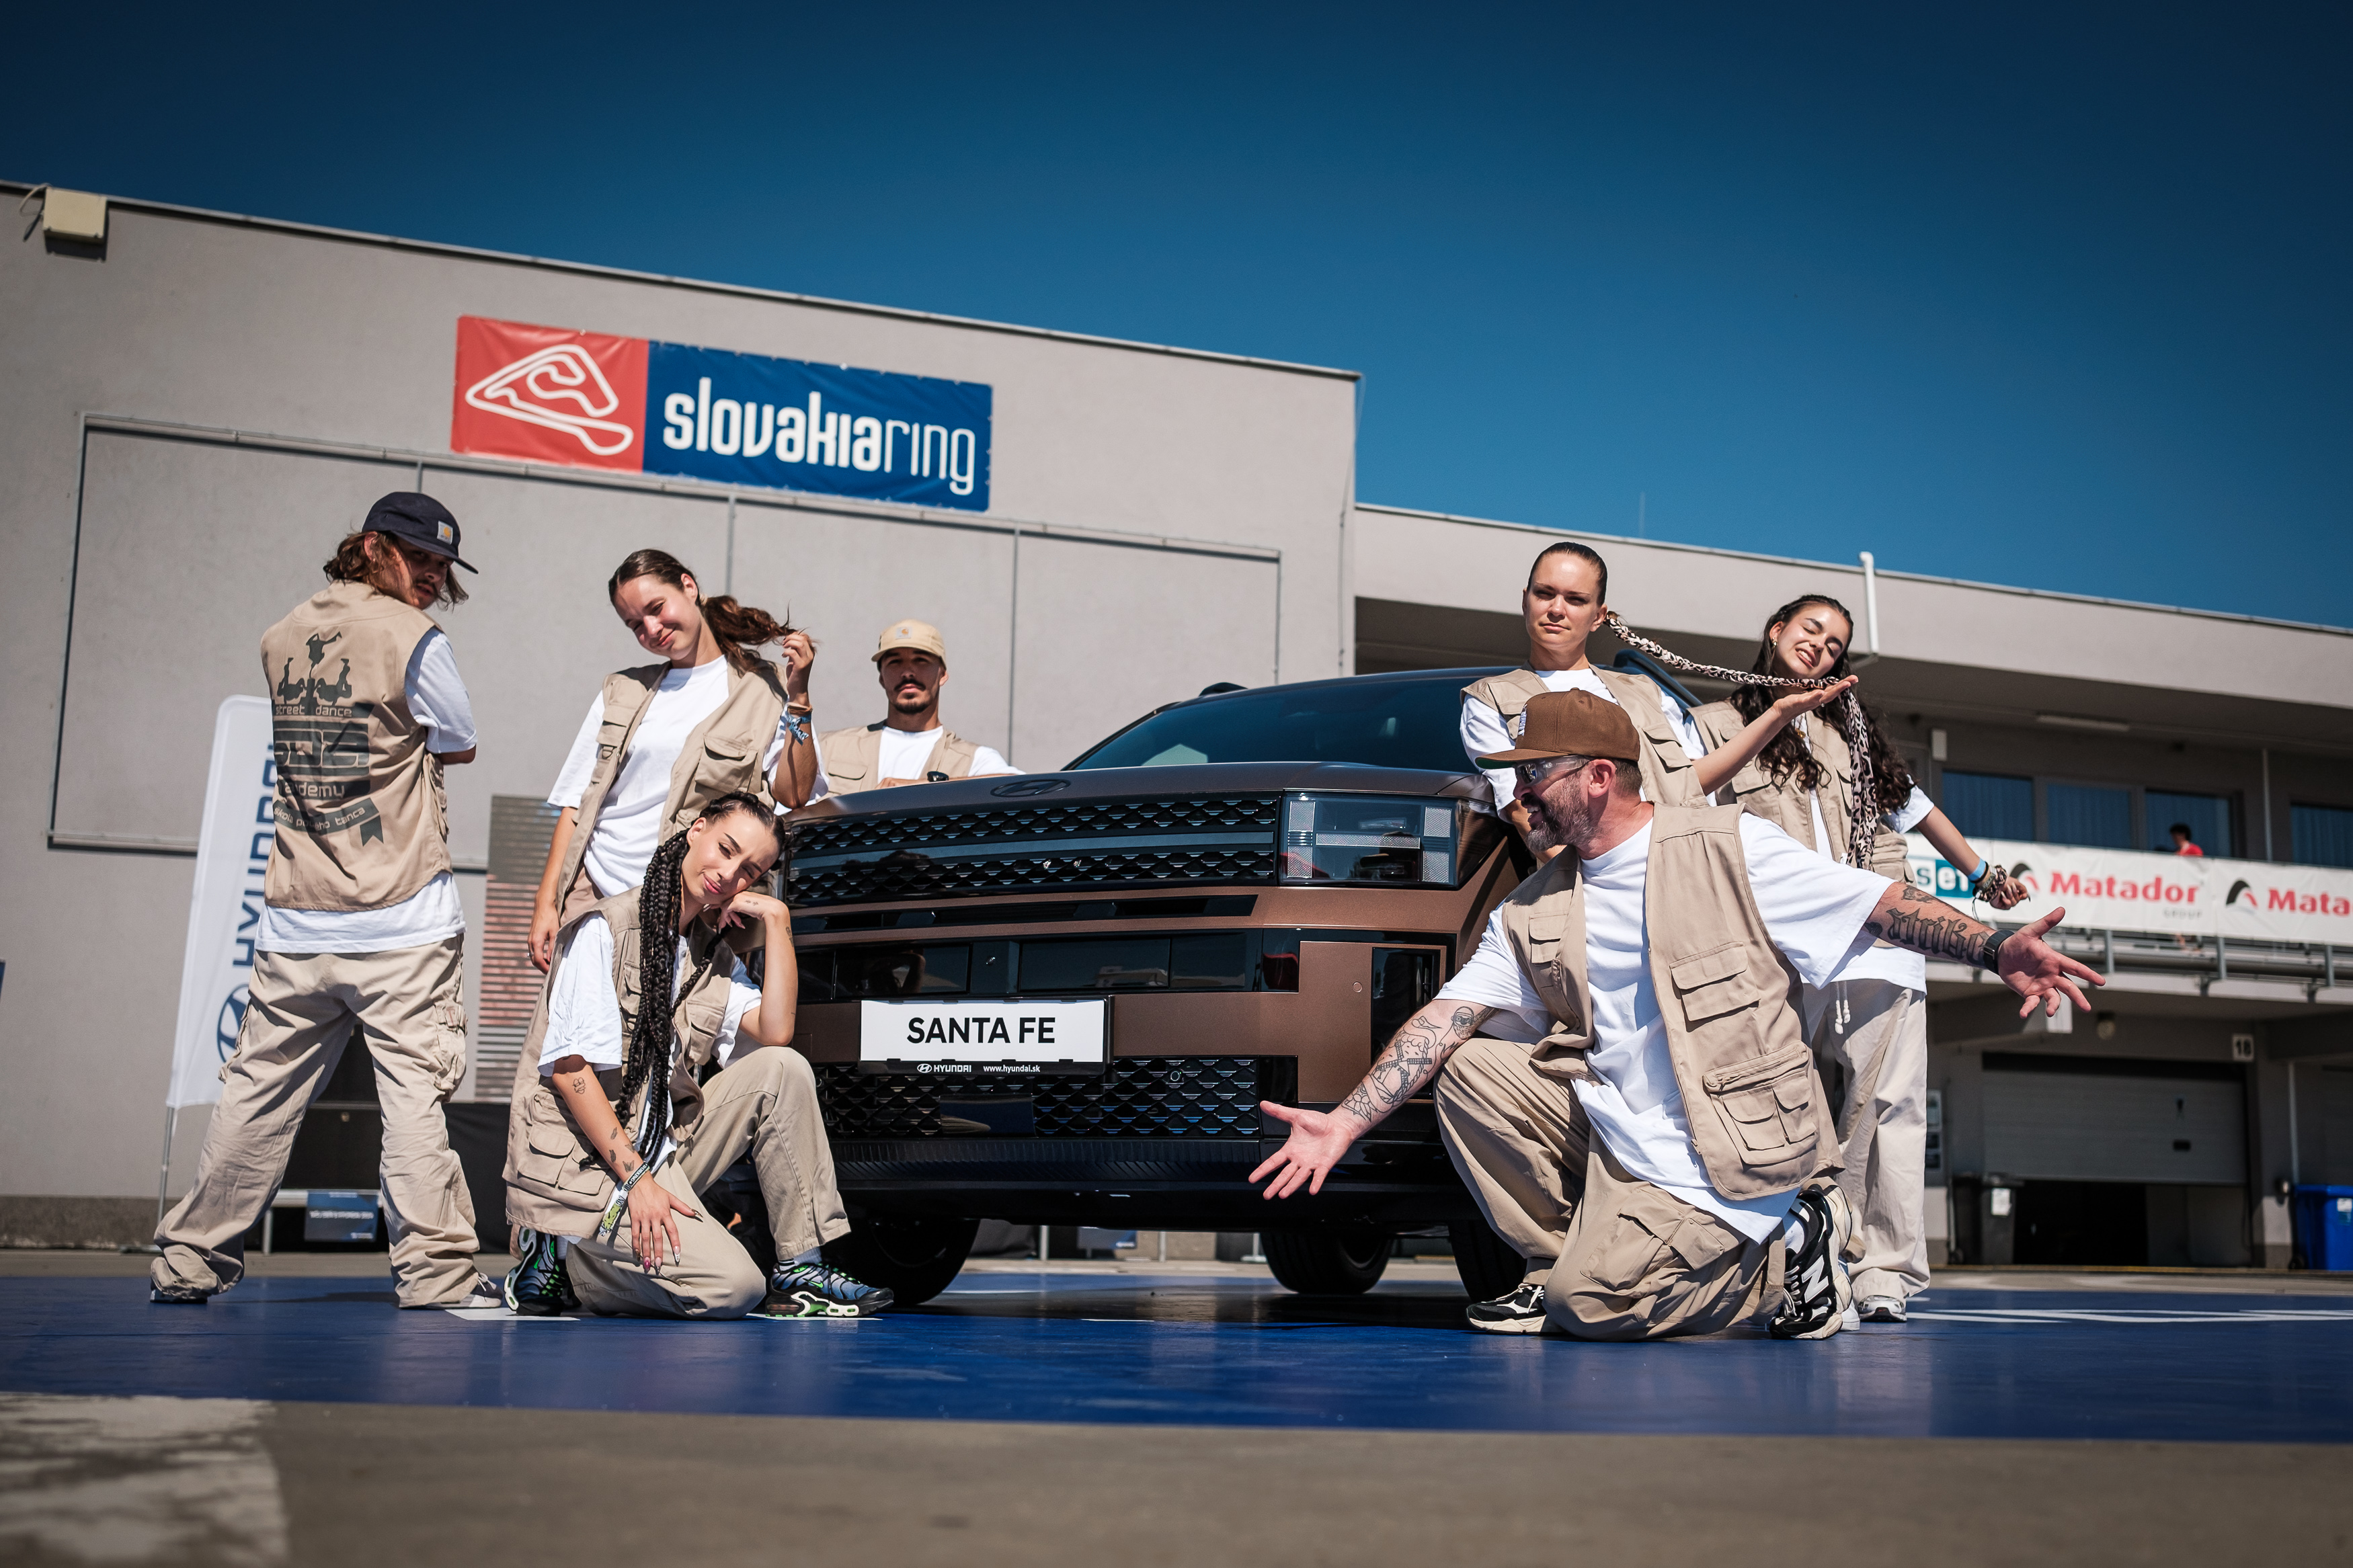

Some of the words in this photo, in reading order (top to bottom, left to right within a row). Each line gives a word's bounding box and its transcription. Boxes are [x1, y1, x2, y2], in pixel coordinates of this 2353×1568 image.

[663, 376, 975, 496] slovakiaring
[276, 704, 305, 715] street
[315, 704, 352, 717] dance
[335, 807, 366, 826] tanca
[2050, 872, 2198, 903] Matador
[907, 1017, 1010, 1044] SANTA
[1019, 1017, 1055, 1044] FE
[933, 1065, 972, 1073] HYUNDAI
[983, 1065, 1041, 1073] www.hyundai.sk
